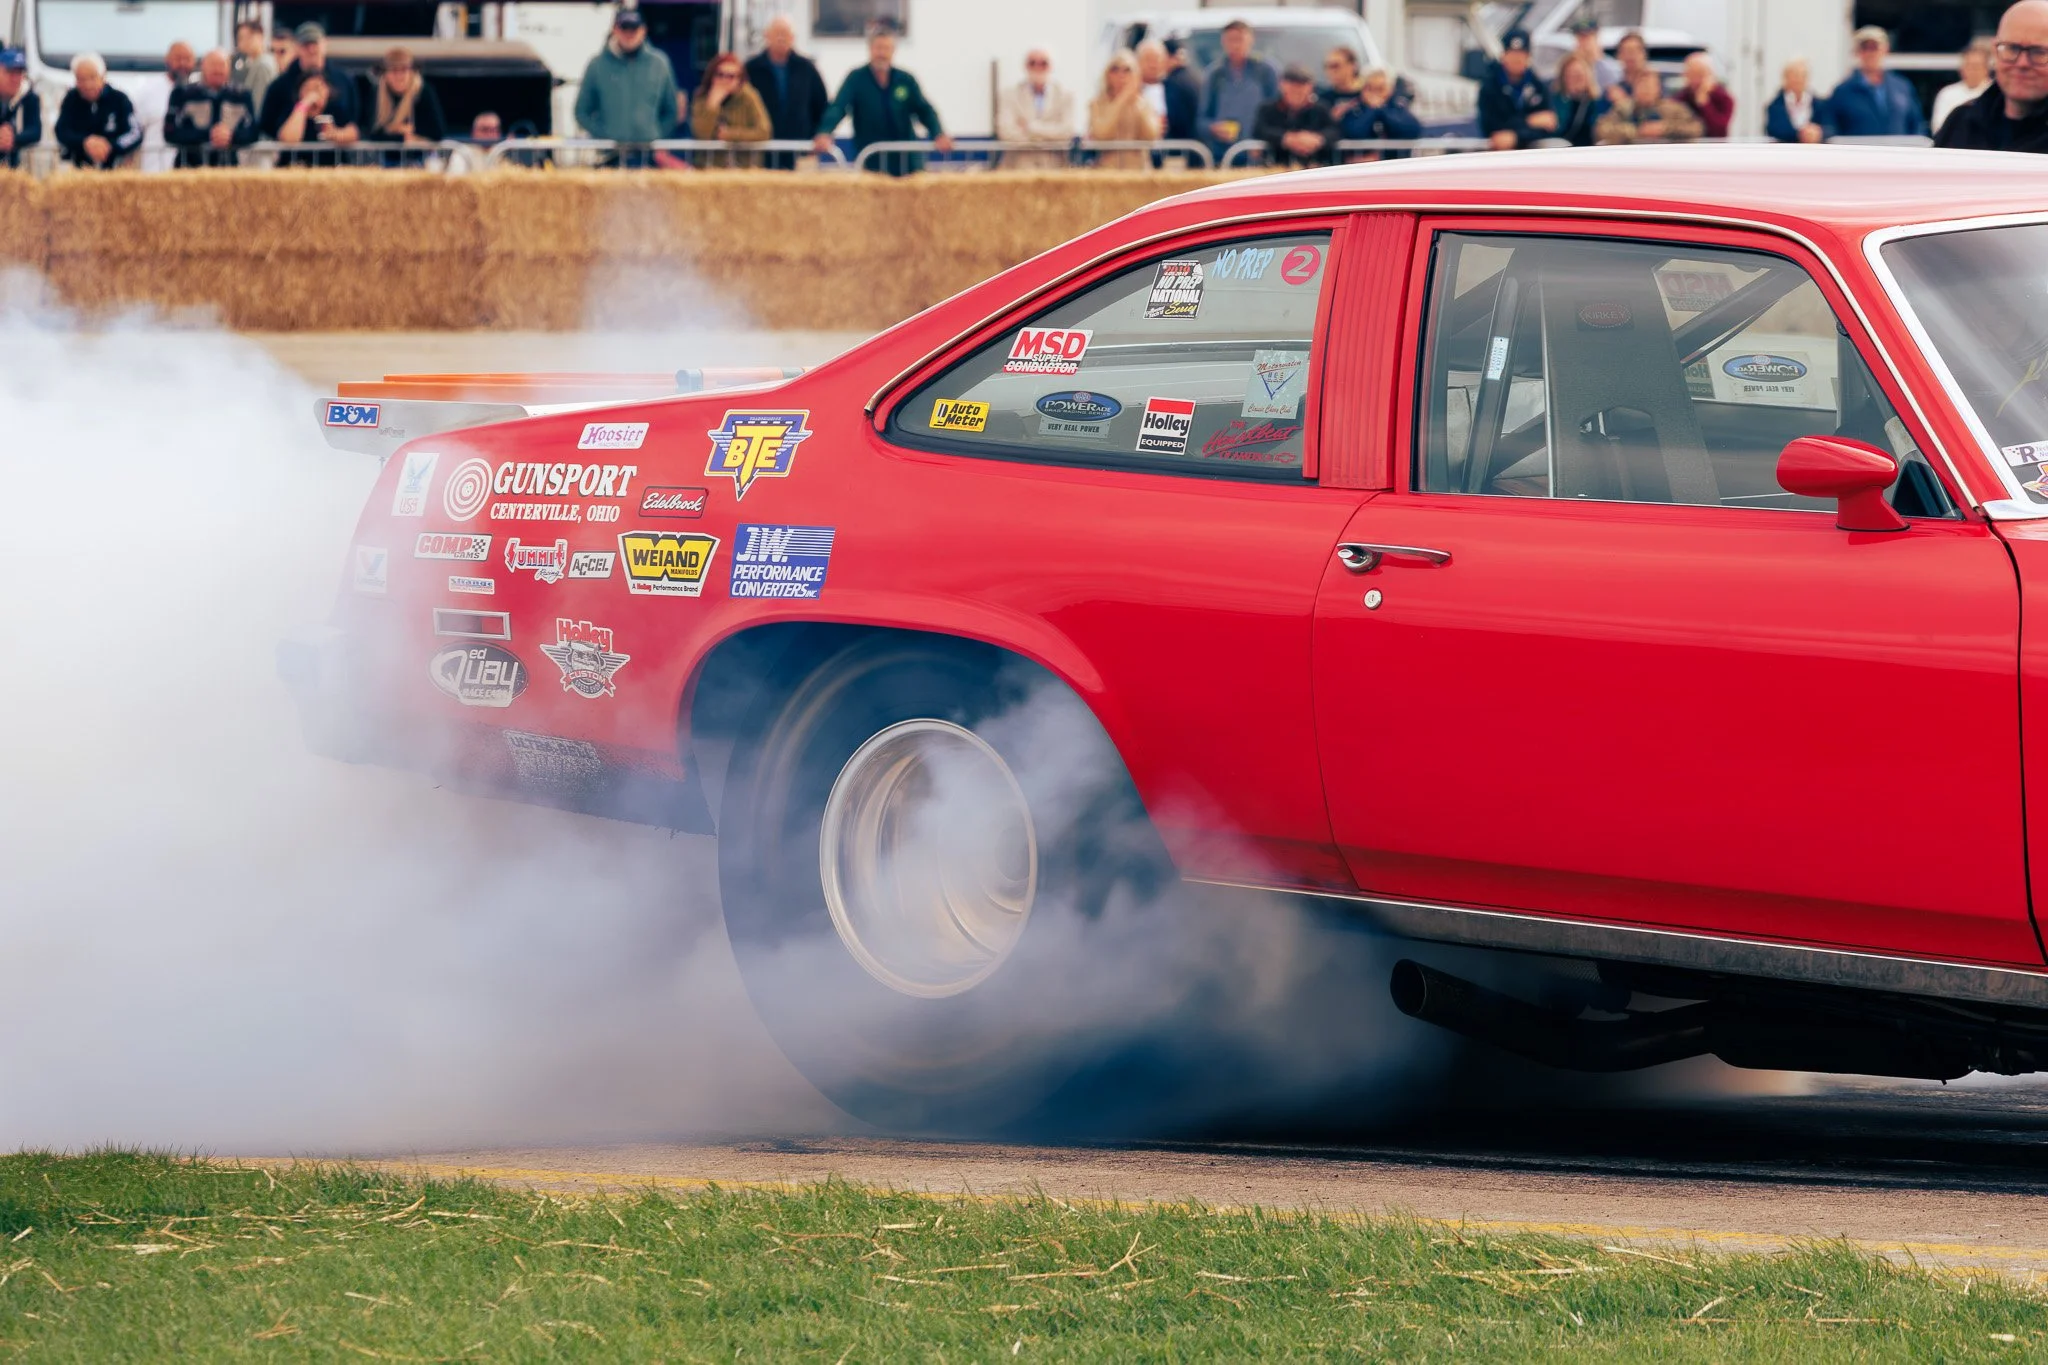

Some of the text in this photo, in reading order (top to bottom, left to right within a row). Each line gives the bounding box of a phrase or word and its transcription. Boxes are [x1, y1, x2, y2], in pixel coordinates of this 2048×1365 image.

[1212, 248, 1275, 280] NO PREP
[1286, 251, 1314, 277] 2
[1156, 275, 1204, 289] NO PREP
[1150, 289, 1201, 303] NATIONAL
[1012, 330, 1087, 359] MSD
[1004, 360, 1078, 374] CONDUCTOR
[1032, 353, 1064, 363] SUPER
[328, 405, 378, 425] B&M
[949, 403, 981, 416] Auto
[944, 414, 984, 427] Meter
[1048, 423, 1100, 433] VERY REAL POWER
[1143, 413, 1190, 436] Holley
[582, 425, 644, 445] Hoosier
[1141, 438, 1185, 448] EQUIPPED
[723, 425, 796, 487] BTE
[493, 461, 638, 498] GUNSPORT
[642, 492, 704, 512] Edelbrock
[490, 502, 620, 523] CENTERVILLE, OHIO
[418, 535, 473, 553] COMP
[735, 526, 794, 563] J.W.
[453, 551, 480, 559] CAMS
[632, 549, 699, 568] WEIAND
[572, 555, 609, 576] ACCEL
[670, 568, 698, 576] MANIFOLDS
[732, 564, 824, 582] PERFORMANCE
[652, 584, 683, 592] Performance
[731, 580, 810, 597] CONVERTERS
[558, 620, 612, 653] Holley
[469, 648, 488, 660] ed
[430, 650, 519, 707] Quay
[569, 670, 606, 685] CUSTOM
